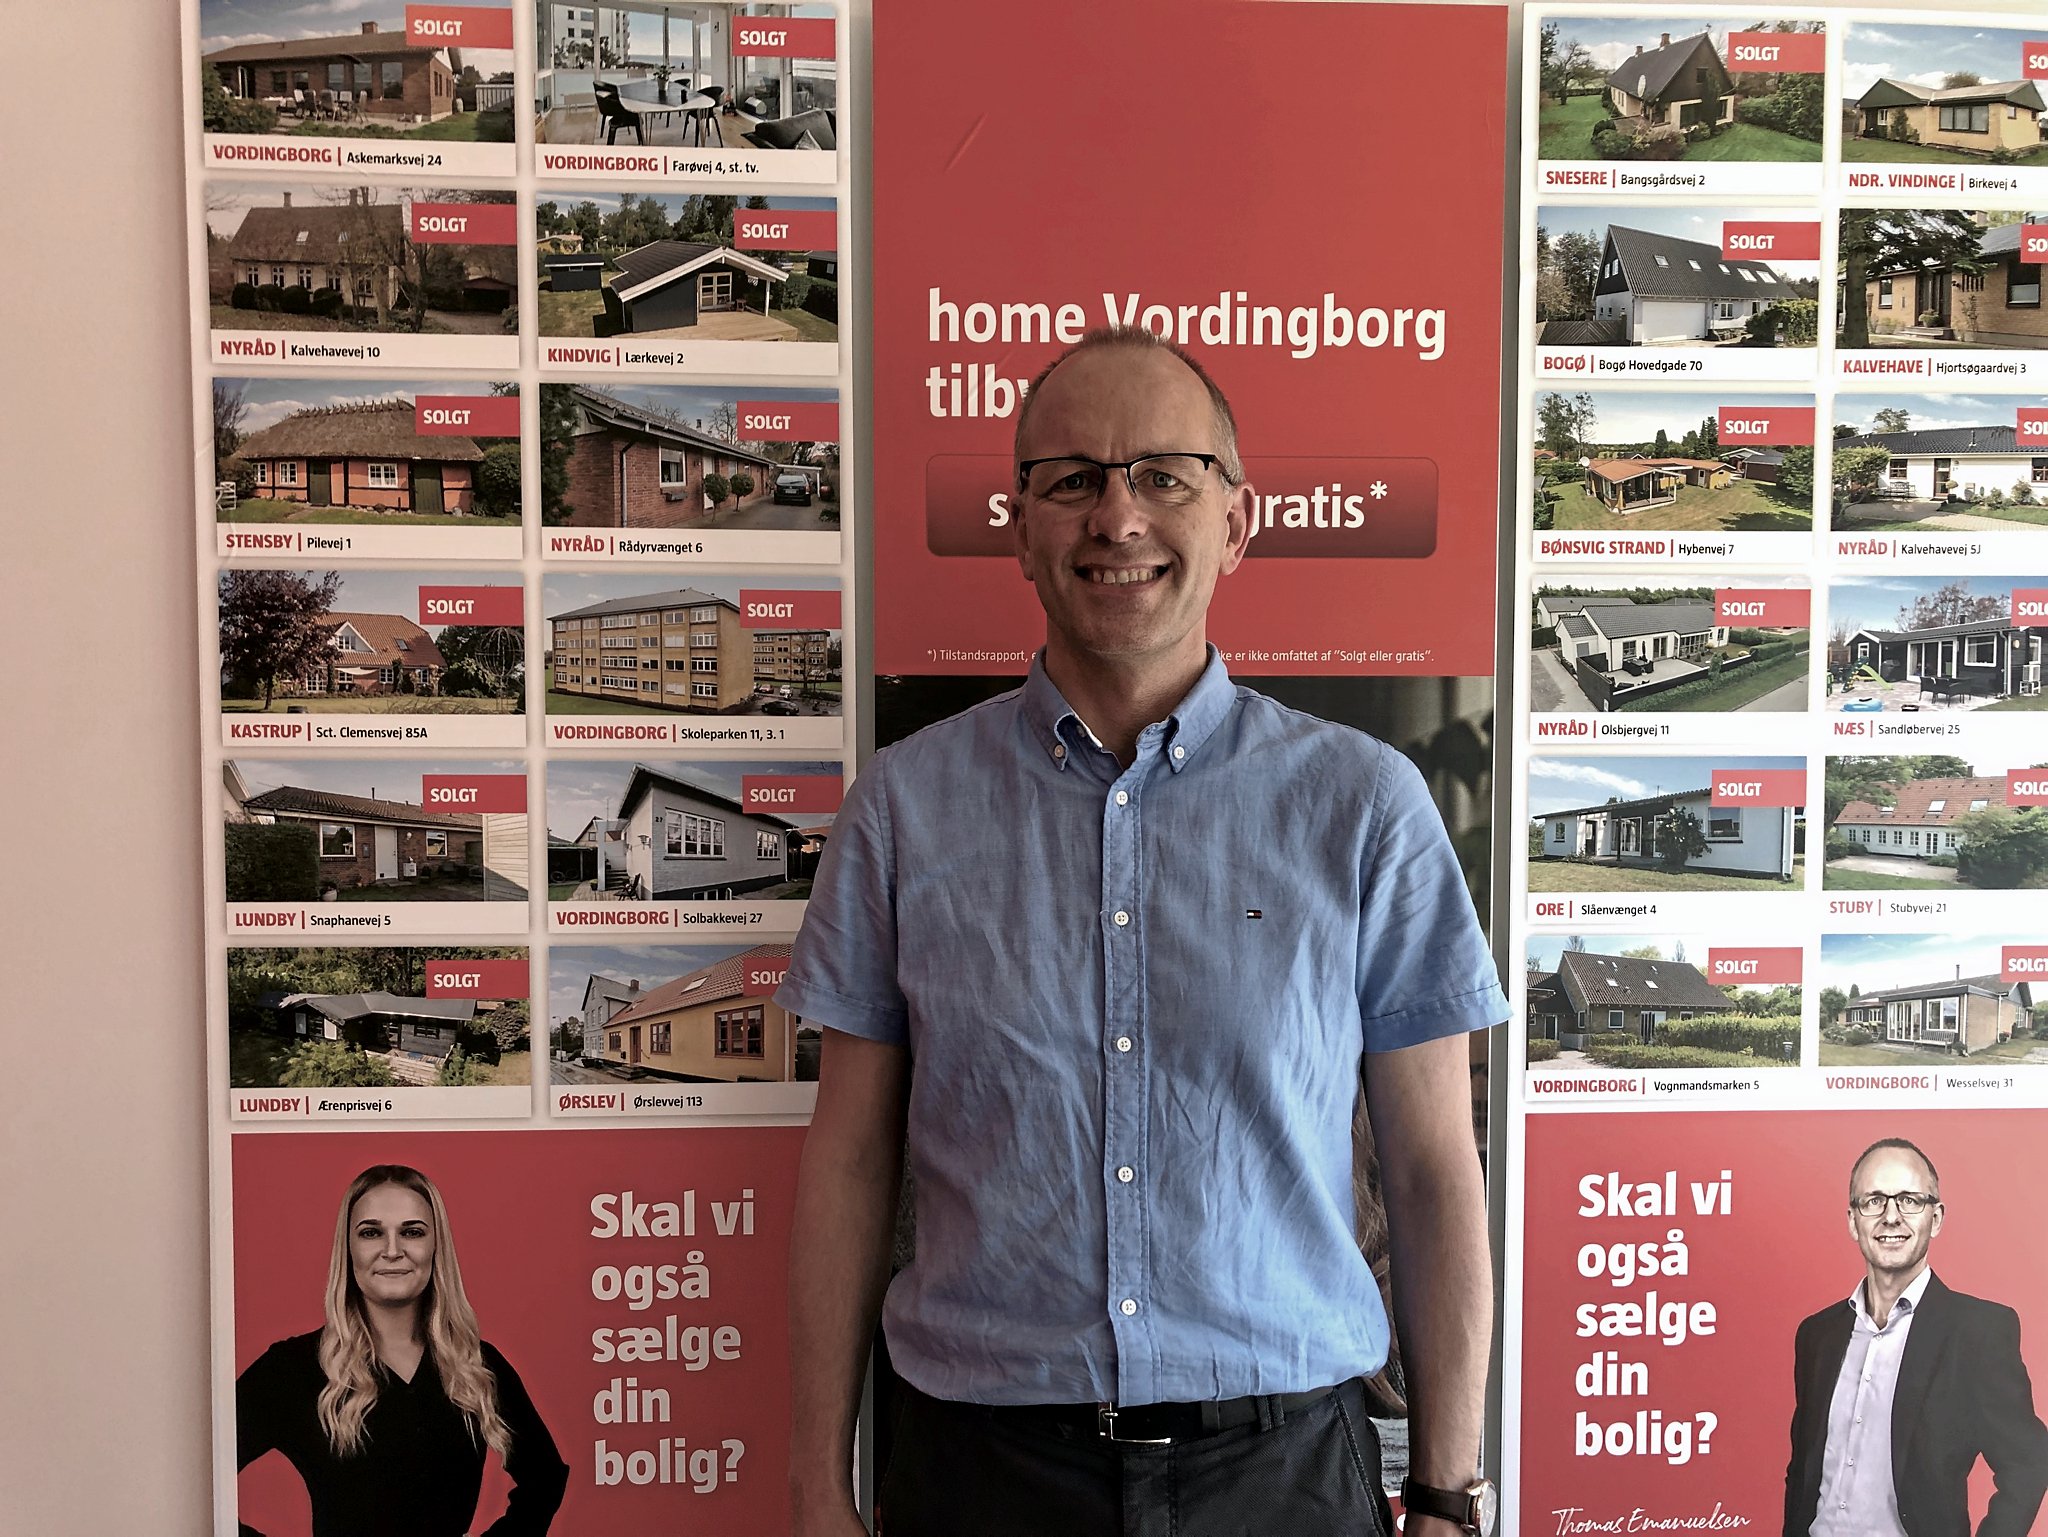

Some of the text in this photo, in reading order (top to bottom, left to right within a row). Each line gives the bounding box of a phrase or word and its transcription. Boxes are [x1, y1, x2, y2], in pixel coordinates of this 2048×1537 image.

[413, 19, 463, 37] SOLGT
[739, 30, 788, 47] SOLGT
[1734, 45, 1781, 61] SOLGT
[212, 144, 333, 163] VORDINGBORG
[346, 151, 442, 168] Askemarksvej 24
[543, 154, 659, 172] VORDINGBORG
[672, 160, 759, 175] Farøvej 4, st. tv.
[1546, 170, 1608, 185] SNESERE
[1620, 173, 1706, 188] Bangsgårdsvej 2
[1848, 173, 1956, 189] NDR. VINDINGE
[1968, 177, 2018, 191] Birkevej 4
[419, 216, 468, 233] SOLGT
[741, 223, 789, 239] SOLGT
[1729, 234, 1775, 250] SOLGT
[929, 286, 1446, 361] home Vordingborg
[220, 337, 277, 356] NYRÅD
[290, 344, 381, 360] Kalvehavevej 10
[547, 347, 612, 364] KINDVIG
[625, 351, 684, 366] Lærkevej 2
[1543, 354, 1586, 373] BOGØ
[1599, 359, 1703, 373] Bogø Hovedgade 70
[1843, 359, 1924, 374] KALVEHAVE
[1936, 361, 2027, 376] Hjortsøgaardvej 3
[423, 409, 471, 425] SOLGT
[744, 414, 792, 430] SOLGT
[1725, 419, 1770, 435] SOLGT
[225, 533, 293, 549] STENSBY
[307, 536, 352, 551] Pilevej 1
[551, 534, 605, 553] NYRÅD
[619, 539, 703, 556] Rådyrvænget 6
[1541, 538, 1666, 557] BØNSVIG STRAND
[1838, 538, 1888, 555] NYRÅD
[1678, 543, 1735, 557] Hybenvej 7
[1901, 543, 1968, 557] Kalvehavevej
[426, 599, 475, 615] SOLGT
[747, 602, 794, 618] SOLGT
[1721, 601, 1766, 617] SOLGT
[939, 649, 1029, 663] Tilstandsrapport,
[1234, 652, 1246, 661] er
[1248, 649, 1270, 662] ikke
[1271, 649, 1318, 662] omfattet
[1320, 649, 1332, 662] af
[1369, 650, 1393, 662] eller
[230, 724, 303, 739] KASTRUP
[315, 726, 428, 741] Sct. Clemensvej 85A
[553, 725, 668, 740] VORDINGBORG
[681, 727, 785, 742] Skoleparken 11, 3. 1
[1538, 718, 1589, 736] NYRÅD
[1601, 724, 1669, 738] Olsbjergvej 11
[1834, 721, 1865, 736] NÆS
[1878, 724, 1961, 737] Sandløbervej 25
[430, 787, 478, 803] SOLGT
[749, 788, 796, 803] SOLGT
[1718, 782, 1763, 797] SOLGT
[1535, 902, 1565, 916] ORE
[1581, 903, 1657, 917] Slåenvænget 4
[1829, 900, 1874, 914] STUBY
[1890, 902, 1947, 915] Stubyvej 21
[235, 912, 297, 927] LUNDBY
[310, 914, 392, 929] Snaphanevej 5
[556, 910, 670, 926] VORDINGBORG
[682, 911, 763, 926] Solbakkevej 27
[1714, 959, 1759, 975] SOLGT
[2007, 957, 2048, 973] SOLGT
[433, 973, 481, 988] SOLGT
[1533, 1079, 1637, 1094] VORDINGBORG
[1653, 1079, 1760, 1094] Vognmandsmarken 5
[1825, 1076, 1929, 1090] VORDINGBORG
[1946, 1077, 2013, 1090] Wesselsvej 31
[239, 1098, 301, 1113] LUNDBY
[317, 1099, 393, 1114] Ærenprisvej 6
[558, 1092, 617, 1112] ØRSLEV
[633, 1094, 703, 1109] Ørslevvej 113
[1578, 1169, 1733, 1218] Skal vi
[590, 1188, 754, 1239] Skal vi
[1577, 1228, 1689, 1287] også
[591, 1250, 710, 1311] også
[1575, 1290, 1717, 1346] sælge
[591, 1314, 741, 1372] sælge
[1575, 1350, 1649, 1397] din
[593, 1376, 671, 1425] din
[1575, 1409, 1718, 1465] bolig?
[594, 1437, 745, 1494] bolig?
[1551, 1501, 1752, 1537] Thomas Emanuelsen
